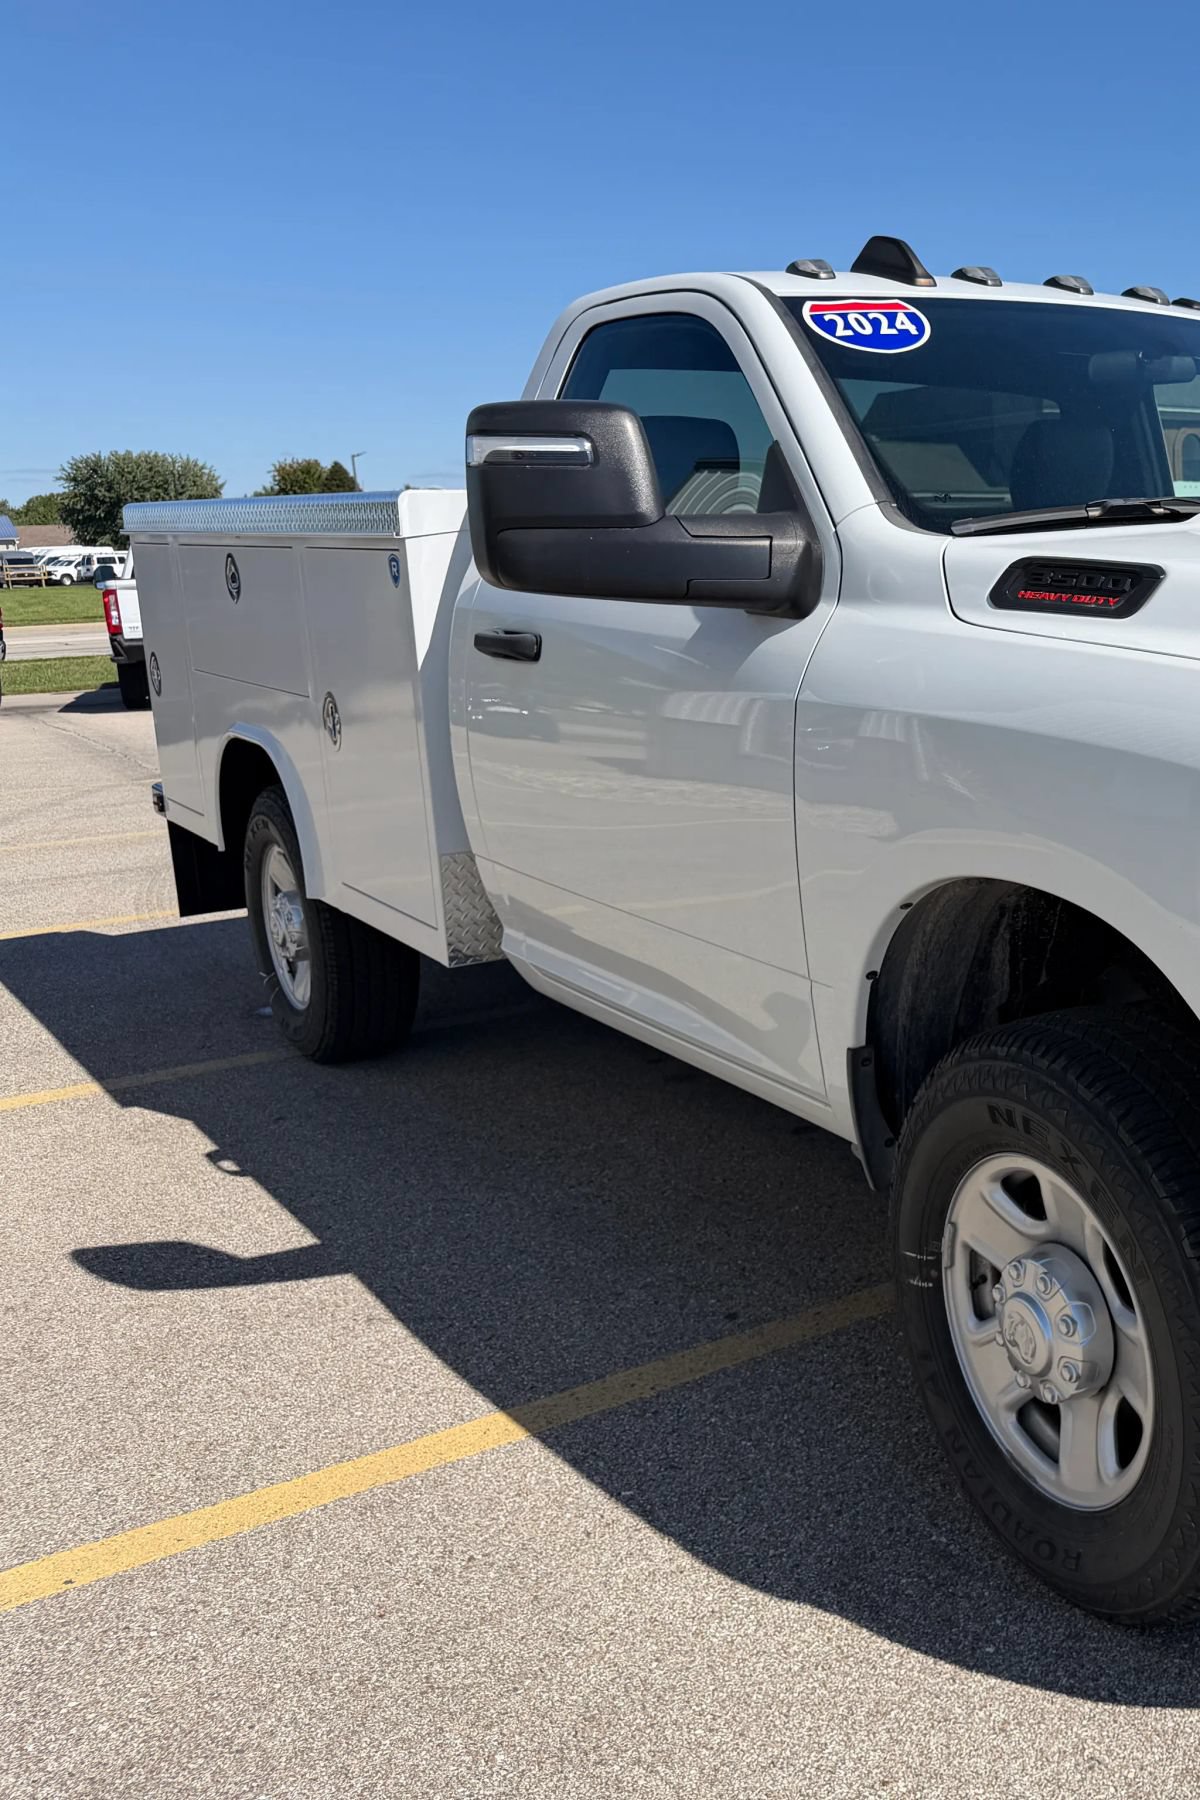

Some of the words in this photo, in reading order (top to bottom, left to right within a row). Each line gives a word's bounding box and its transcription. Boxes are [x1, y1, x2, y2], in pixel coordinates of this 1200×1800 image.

[823, 312, 920, 337] 2024
[390, 561, 399, 577] R
[1017, 590, 1073, 603] HEAVY
[1072, 594, 1121, 607] DUTY
[987, 1103, 1151, 1283] NEXEN
